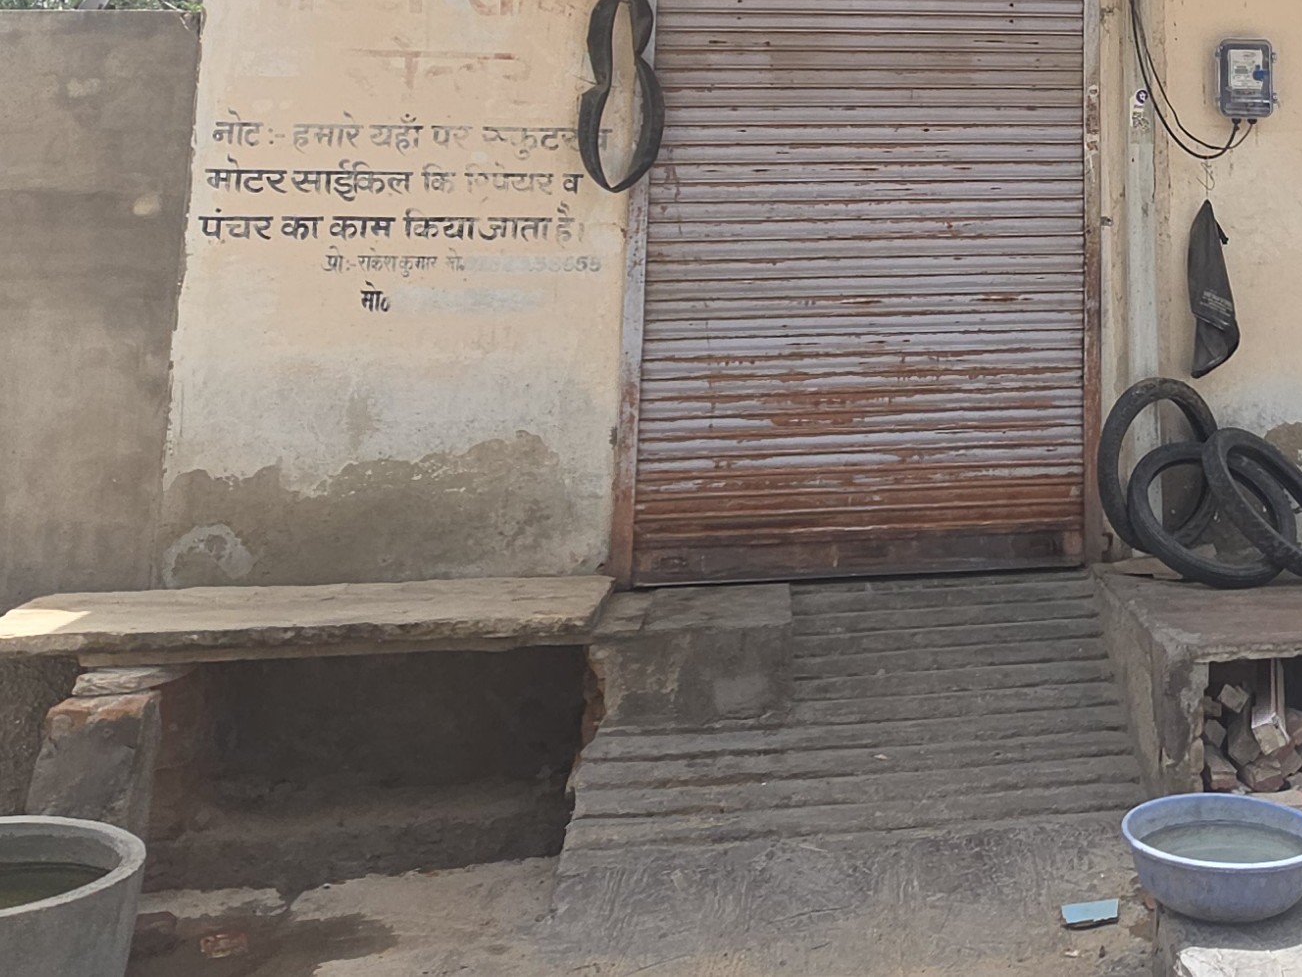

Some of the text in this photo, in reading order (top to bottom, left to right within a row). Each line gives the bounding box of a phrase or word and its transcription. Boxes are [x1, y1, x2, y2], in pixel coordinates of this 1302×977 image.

[292, 111, 364, 154] हमारे
[369, 113, 424, 155] यहाँ
[431, 125, 473, 149] पर
[562, 173, 584, 195] व
[198, 208, 274, 241] पंचर
[281, 216, 324, 241] का
[330, 216, 396, 241] काम
[403, 207, 479, 241] किया
[478, 216, 552, 242] जाता
